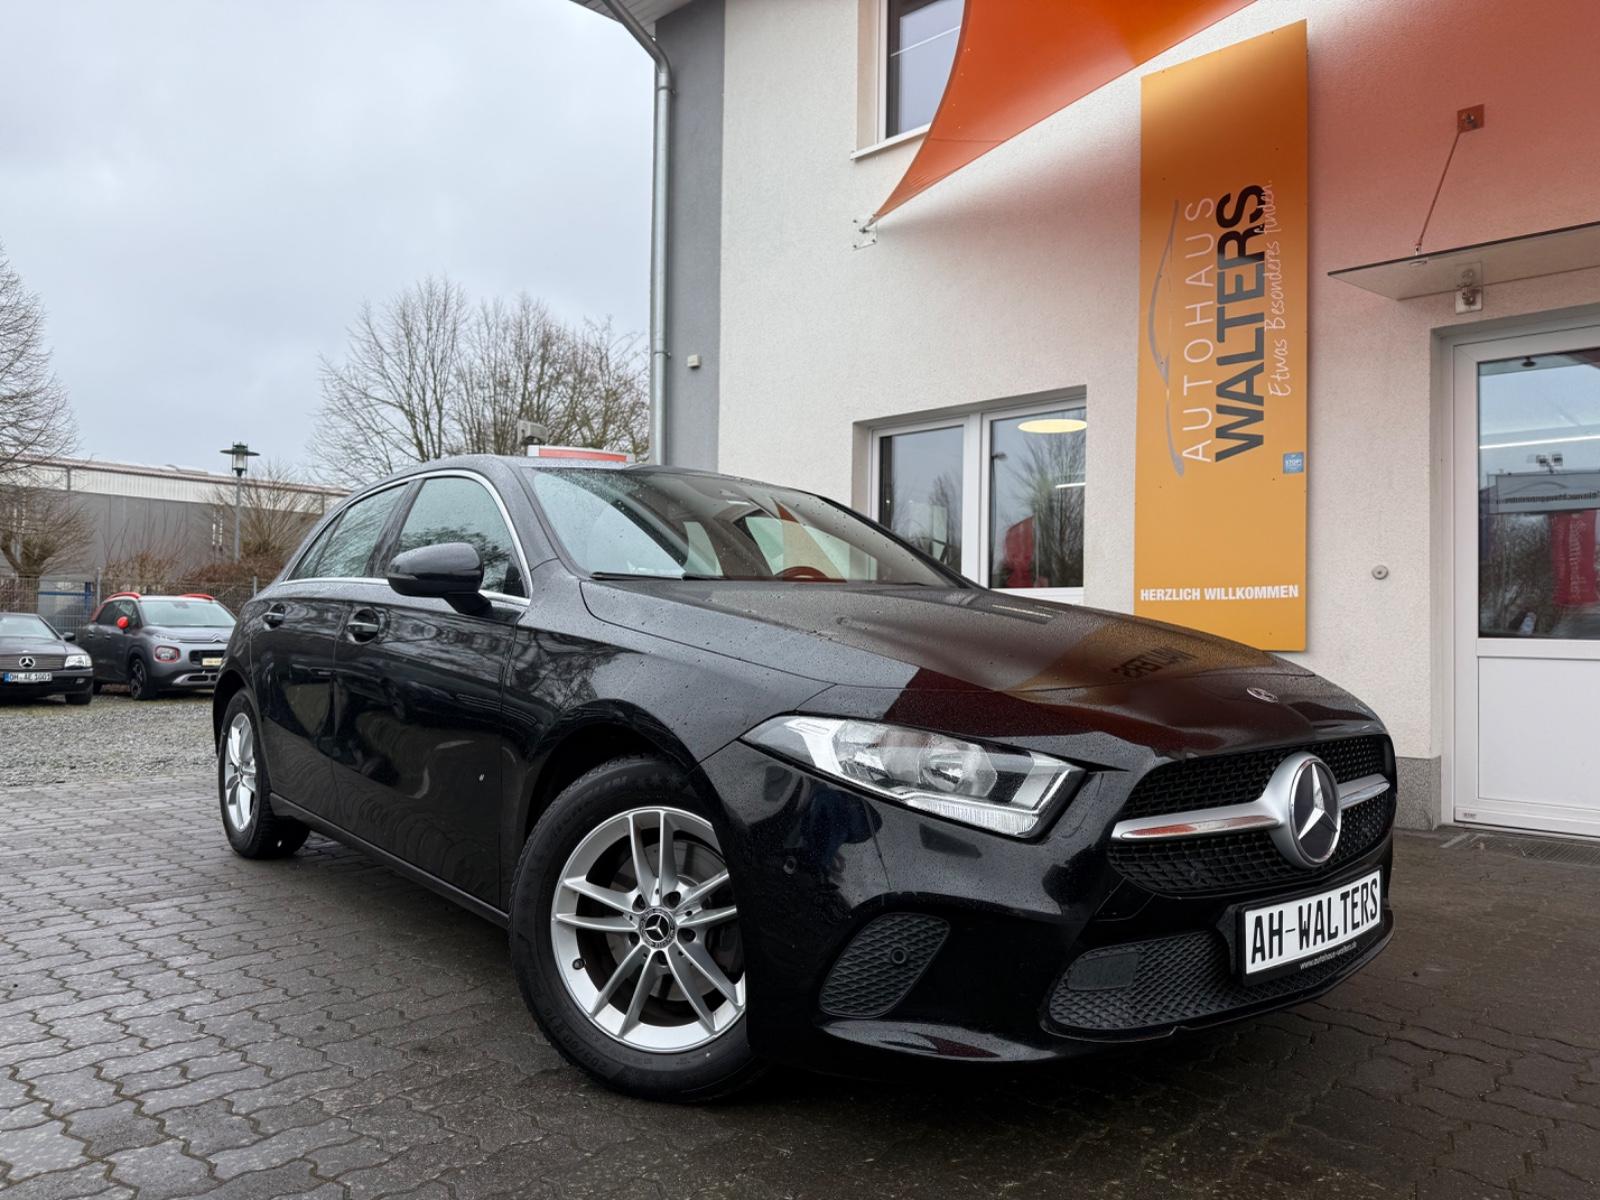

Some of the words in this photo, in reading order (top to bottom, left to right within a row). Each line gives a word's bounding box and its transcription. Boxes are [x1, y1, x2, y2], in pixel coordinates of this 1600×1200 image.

[1182, 198, 1215, 462] AUTOHAUS
[1215, 184, 1265, 463] WALTERS
[1263, 240, 1286, 333] Besonderes
[1267, 338, 1291, 397] Etwas
[1140, 587, 1201, 601] HERZLICH
[1203, 584, 1299, 601] WILLKOMMEN
[1251, 878, 1378, 965] AH-WALTERS
